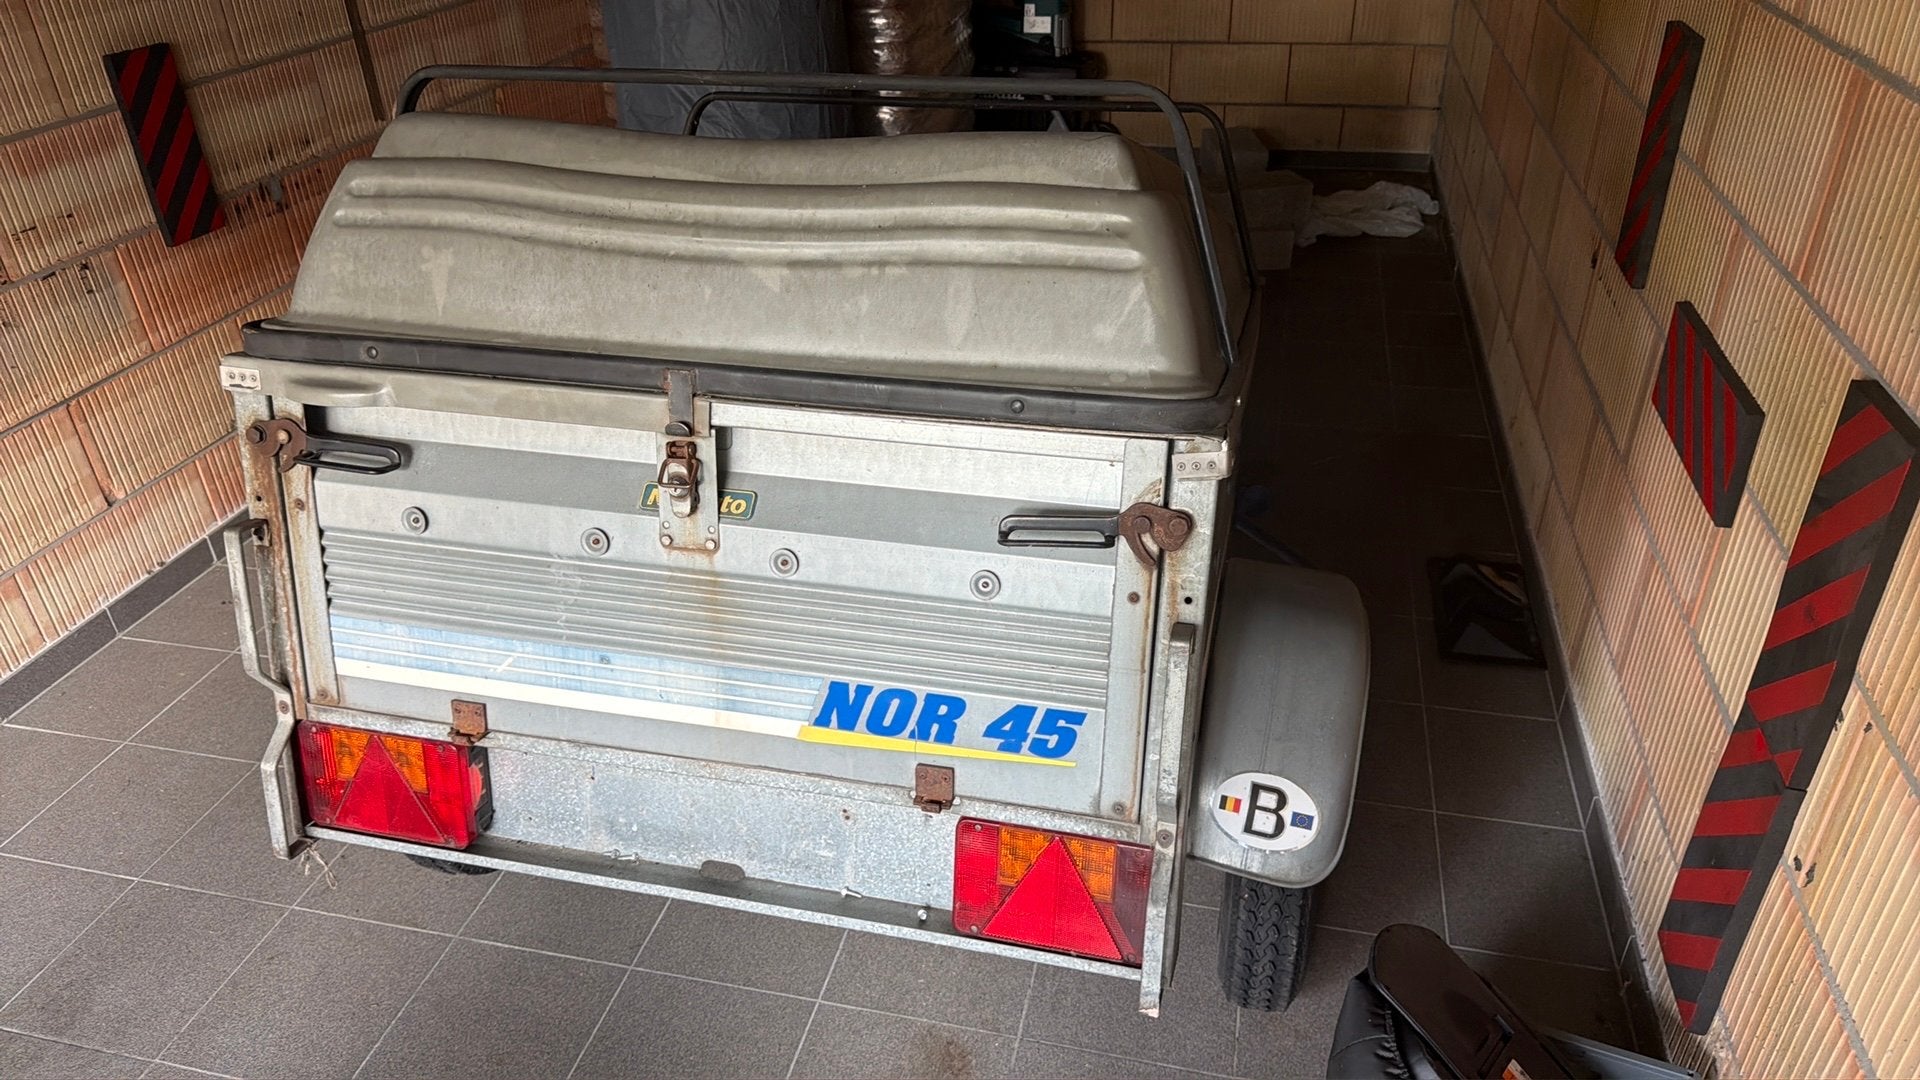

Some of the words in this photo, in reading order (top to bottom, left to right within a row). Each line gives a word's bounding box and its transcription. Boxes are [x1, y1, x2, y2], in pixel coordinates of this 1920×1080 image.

[812, 681, 967, 744] NOR
[982, 704, 1088, 758] 45
[1243, 781, 1287, 838] B
